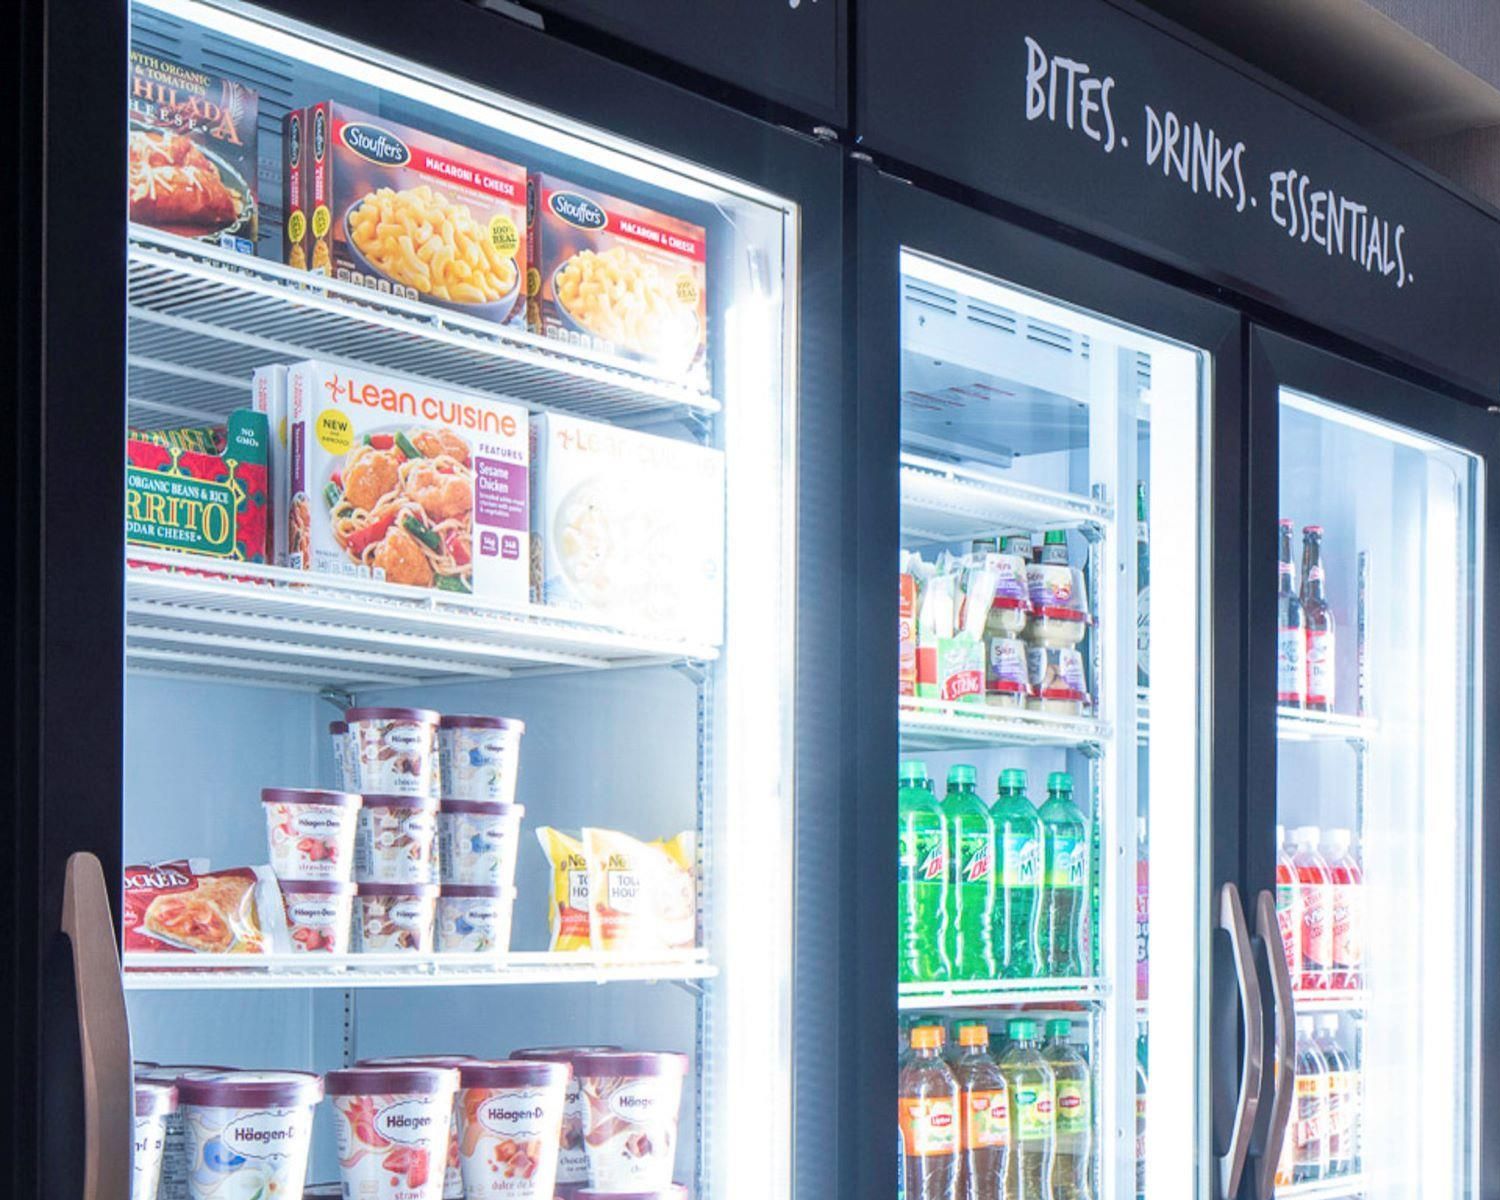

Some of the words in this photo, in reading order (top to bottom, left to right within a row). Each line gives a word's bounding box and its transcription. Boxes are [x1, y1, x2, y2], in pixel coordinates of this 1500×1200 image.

[349, 125, 404, 160] Stouffer's
[1024, 36, 1129, 152] BITES.
[1145, 105, 1258, 213] DRINKS.
[1269, 170, 1414, 288] ESSENTIALS.
[425, 156, 472, 183] MACARONI
[482, 176, 515, 196] CHEESE
[554, 195, 601, 224] Stouffer's
[619, 221, 659, 242] MACARONI
[668, 235, 696, 255] CHEESE
[241, 427, 255, 437] NO
[323, 418, 348, 432] NEW
[479, 443, 524, 460] FEATURES
[479, 462, 510, 479] Sesame
[171, 482, 201, 500] BEANS
[479, 477, 510, 494] Chicken
